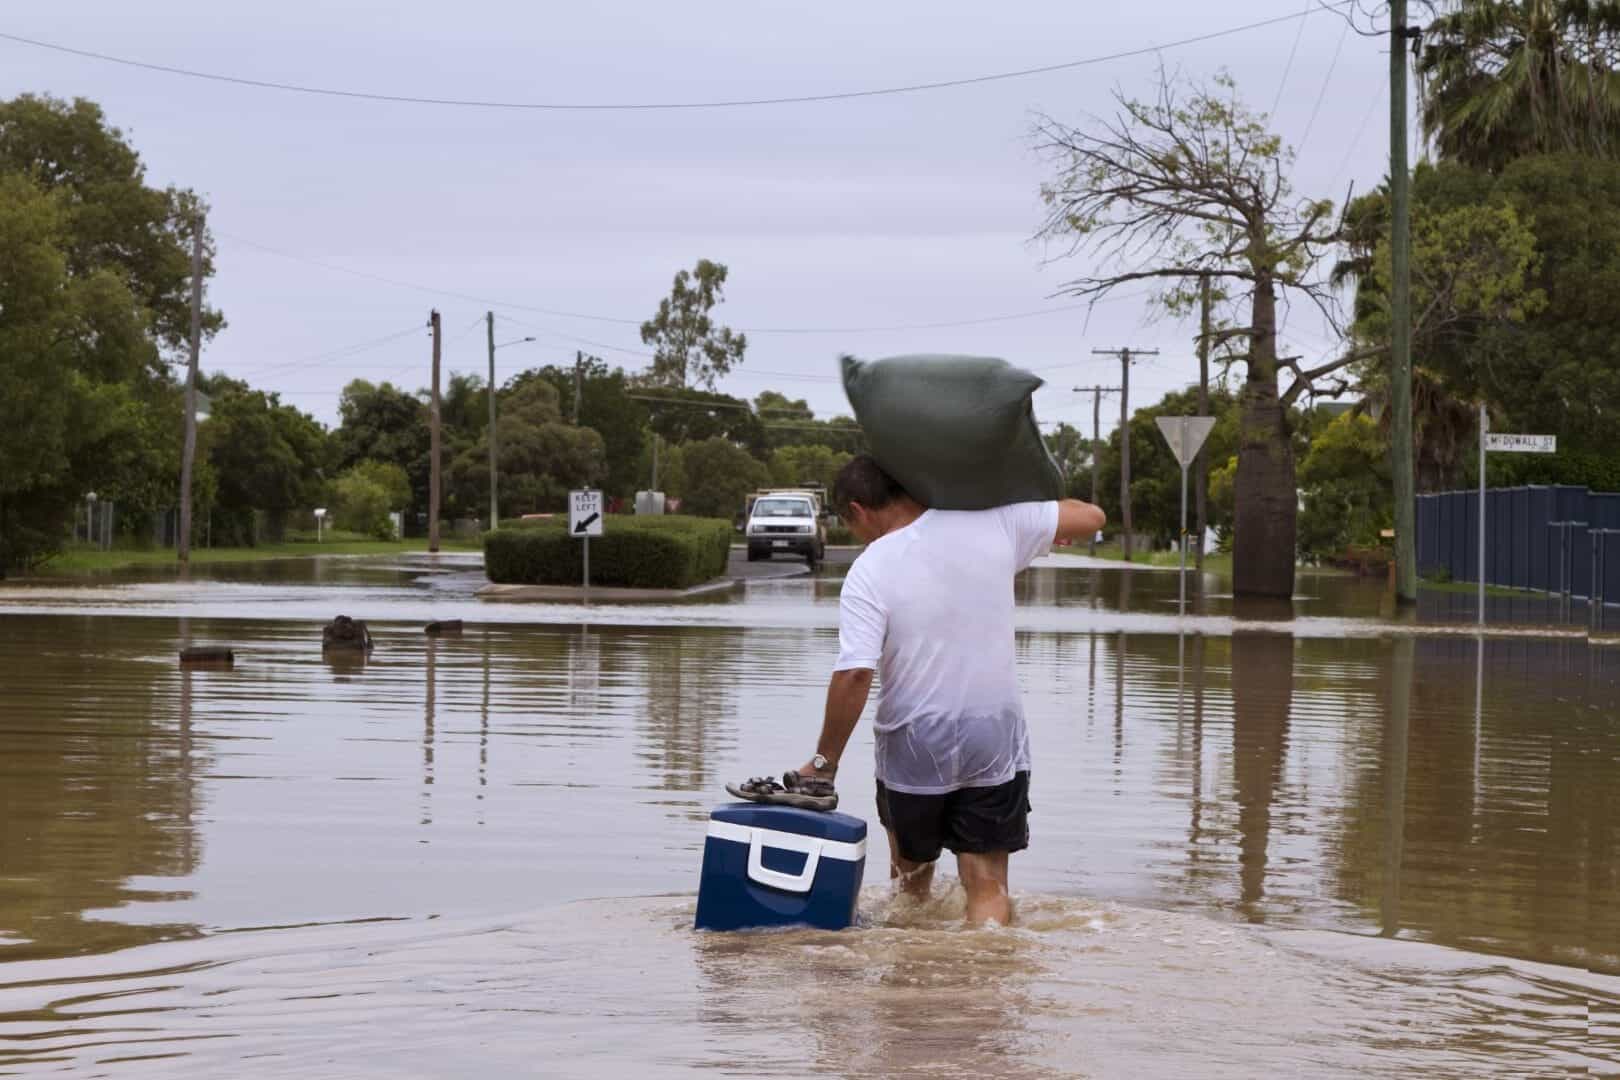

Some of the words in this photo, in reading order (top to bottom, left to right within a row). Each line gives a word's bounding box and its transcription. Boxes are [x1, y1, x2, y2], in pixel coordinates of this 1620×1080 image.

[1543, 436, 1553, 448] ST
[575, 495, 598, 503] KEEP
[576, 503, 596, 512] LEFT
